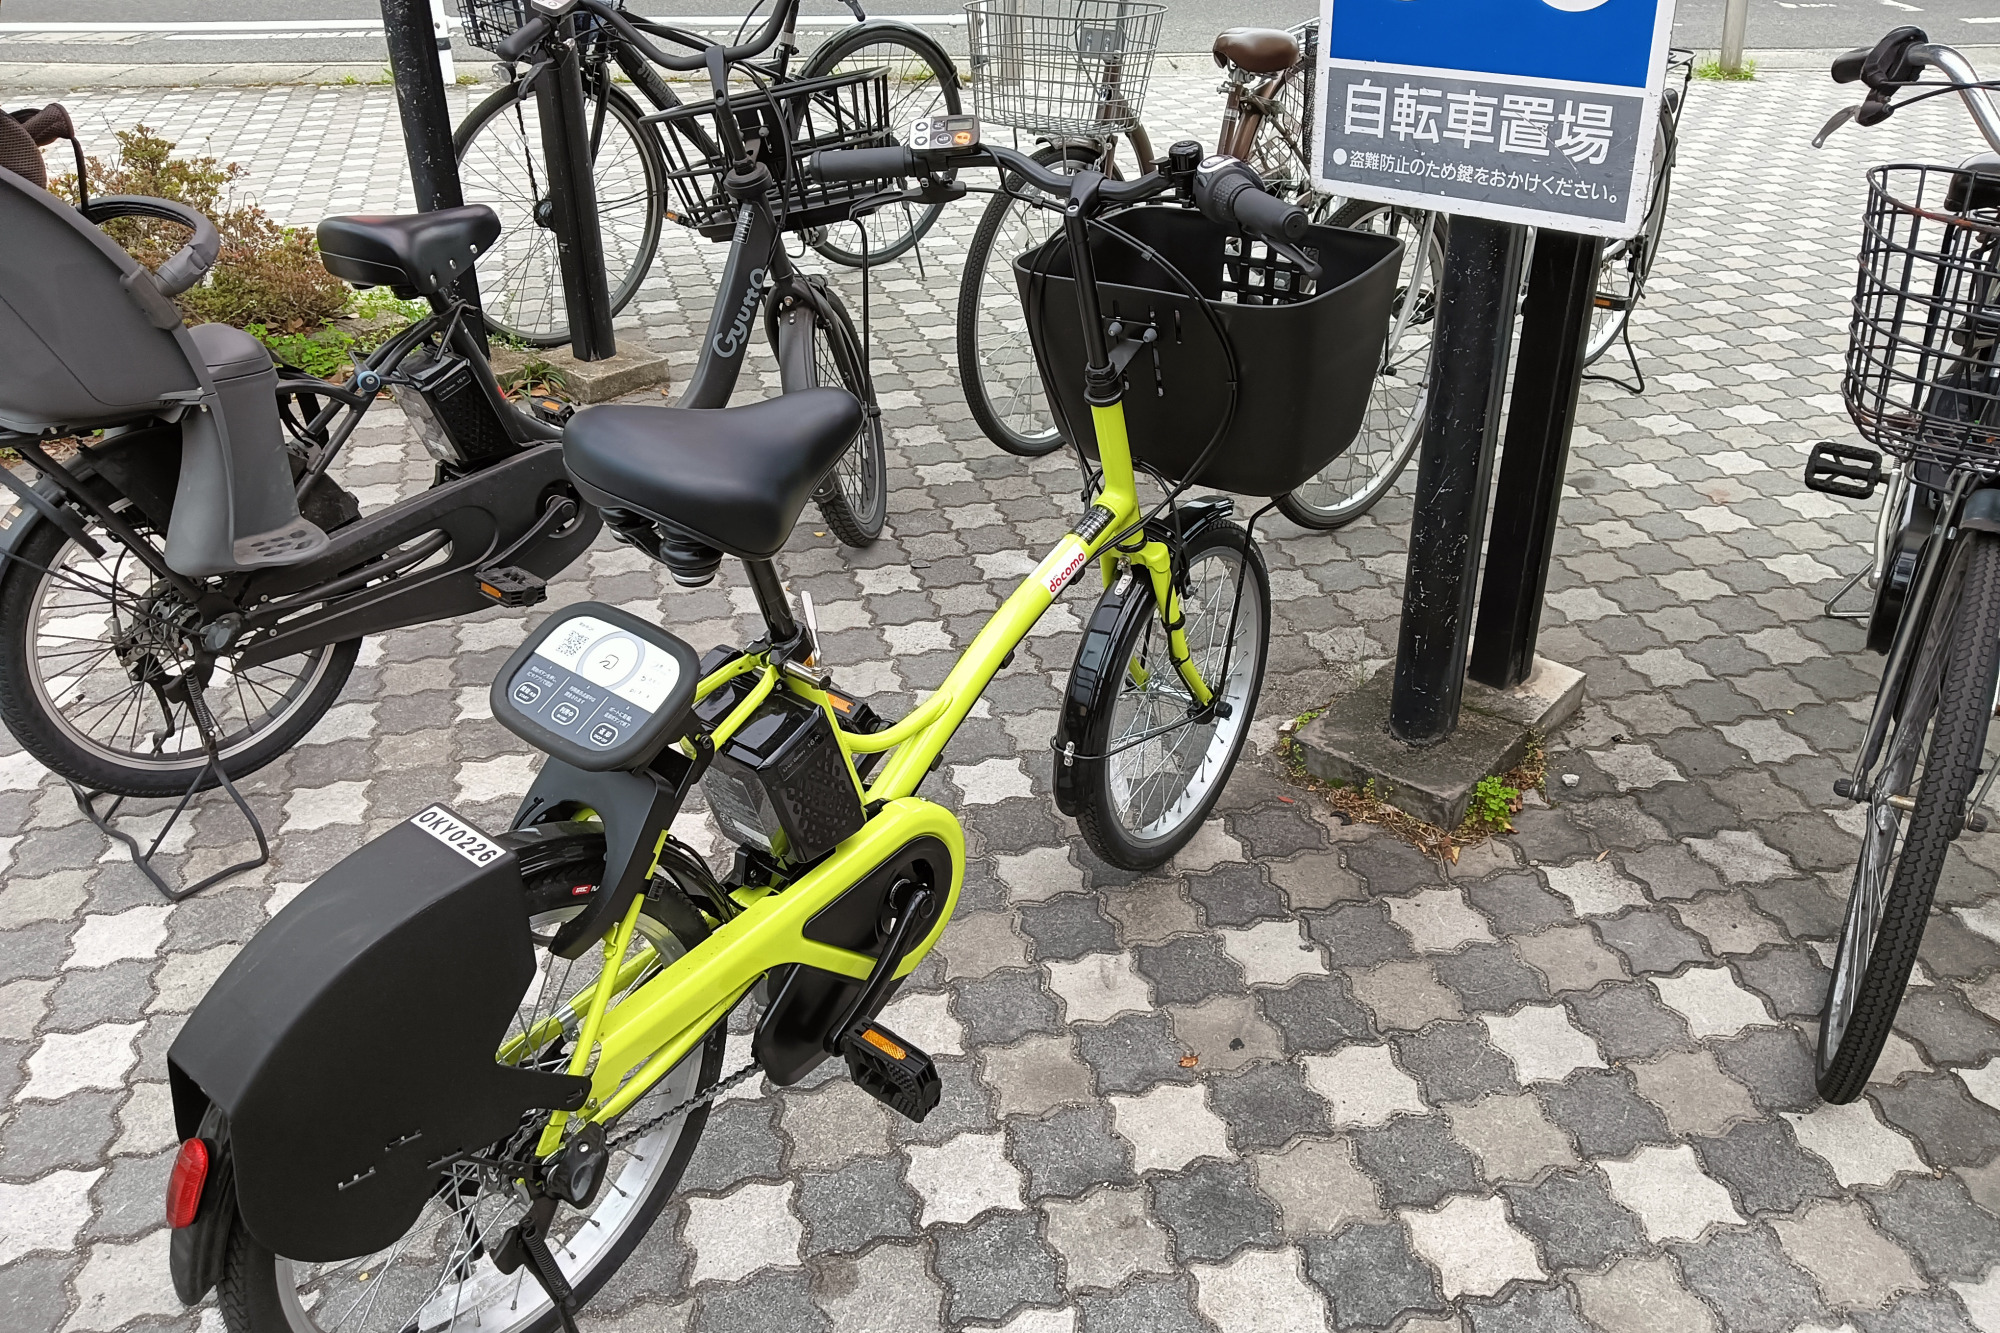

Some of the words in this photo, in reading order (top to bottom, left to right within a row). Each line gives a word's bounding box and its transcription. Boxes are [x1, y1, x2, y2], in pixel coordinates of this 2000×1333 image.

[1343, 78, 1614, 166] 自転車置場
[1349, 149, 1618, 204] 盗難防止のため鍵をおかけください。
[712, 268, 766, 358] Gyutto
[1049, 552, 1085, 593] docomo
[418, 811, 498, 862] OKY0226
